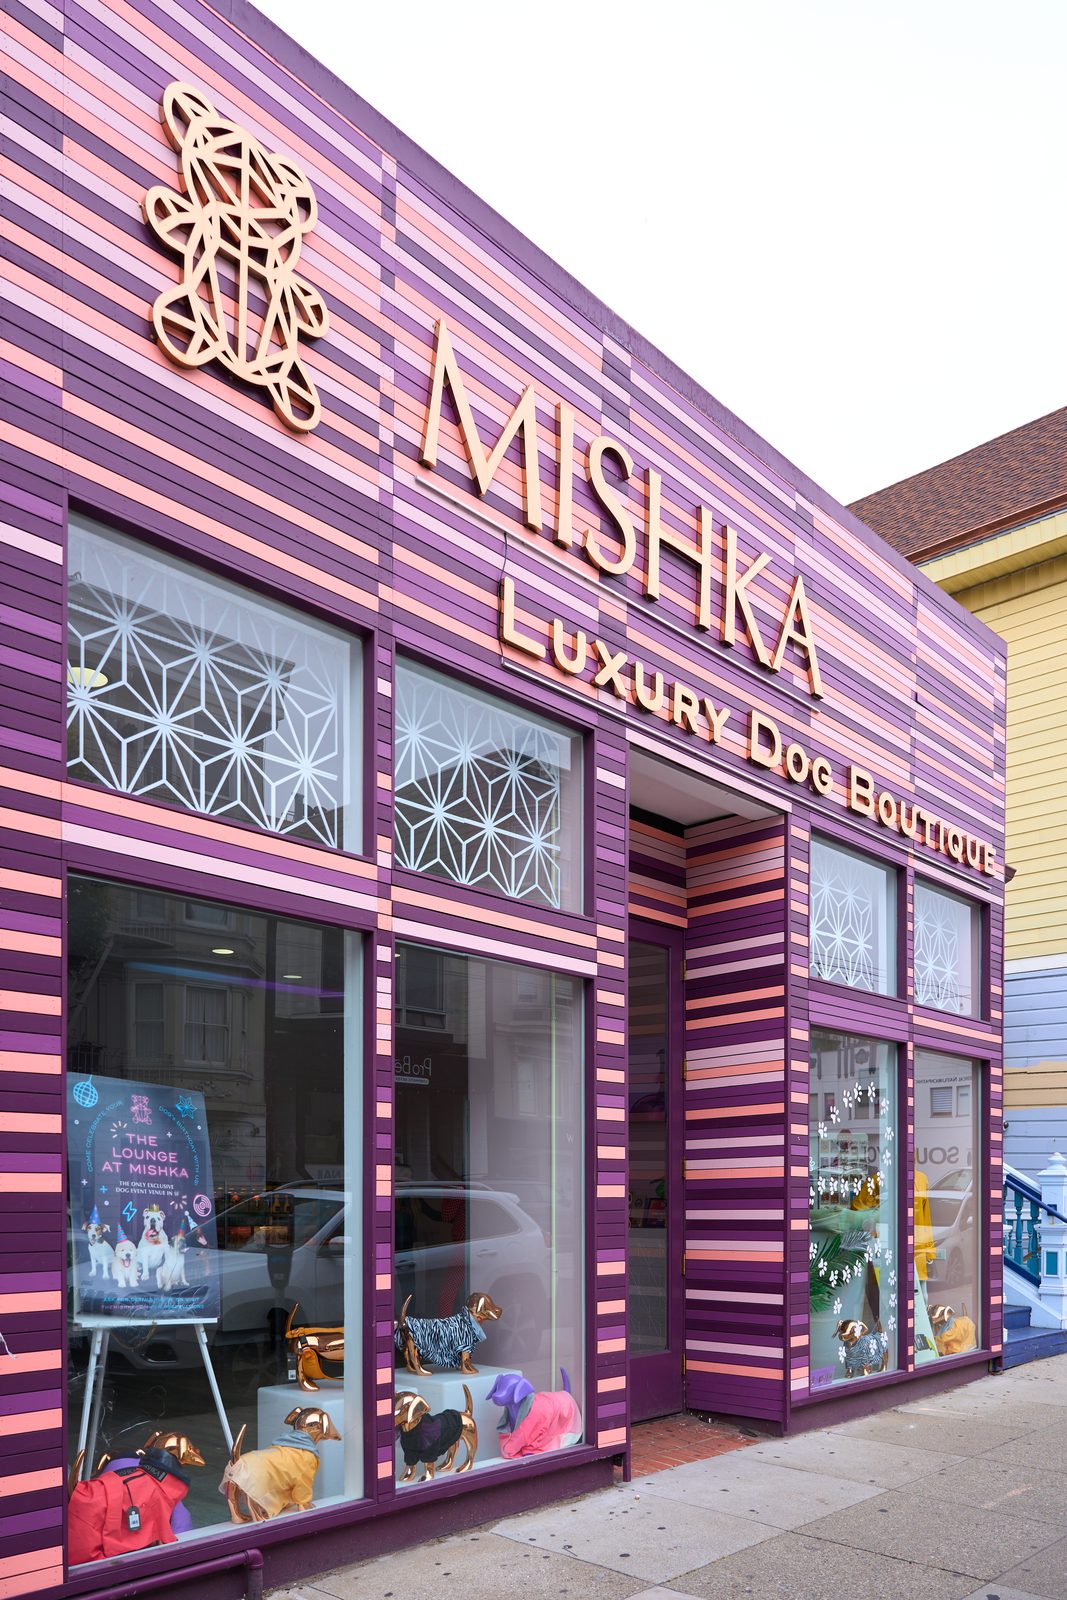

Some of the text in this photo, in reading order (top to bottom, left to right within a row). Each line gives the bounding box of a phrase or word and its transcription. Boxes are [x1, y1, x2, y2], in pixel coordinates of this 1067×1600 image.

[417, 318, 824, 700] MISHKA
[125, 1133, 158, 1147] THE
[112, 1146, 178, 1163] LOUNGE
[101, 1161, 189, 1179] AT MISHKA
[147, 1182, 175, 1190] EXCLUSIVE
